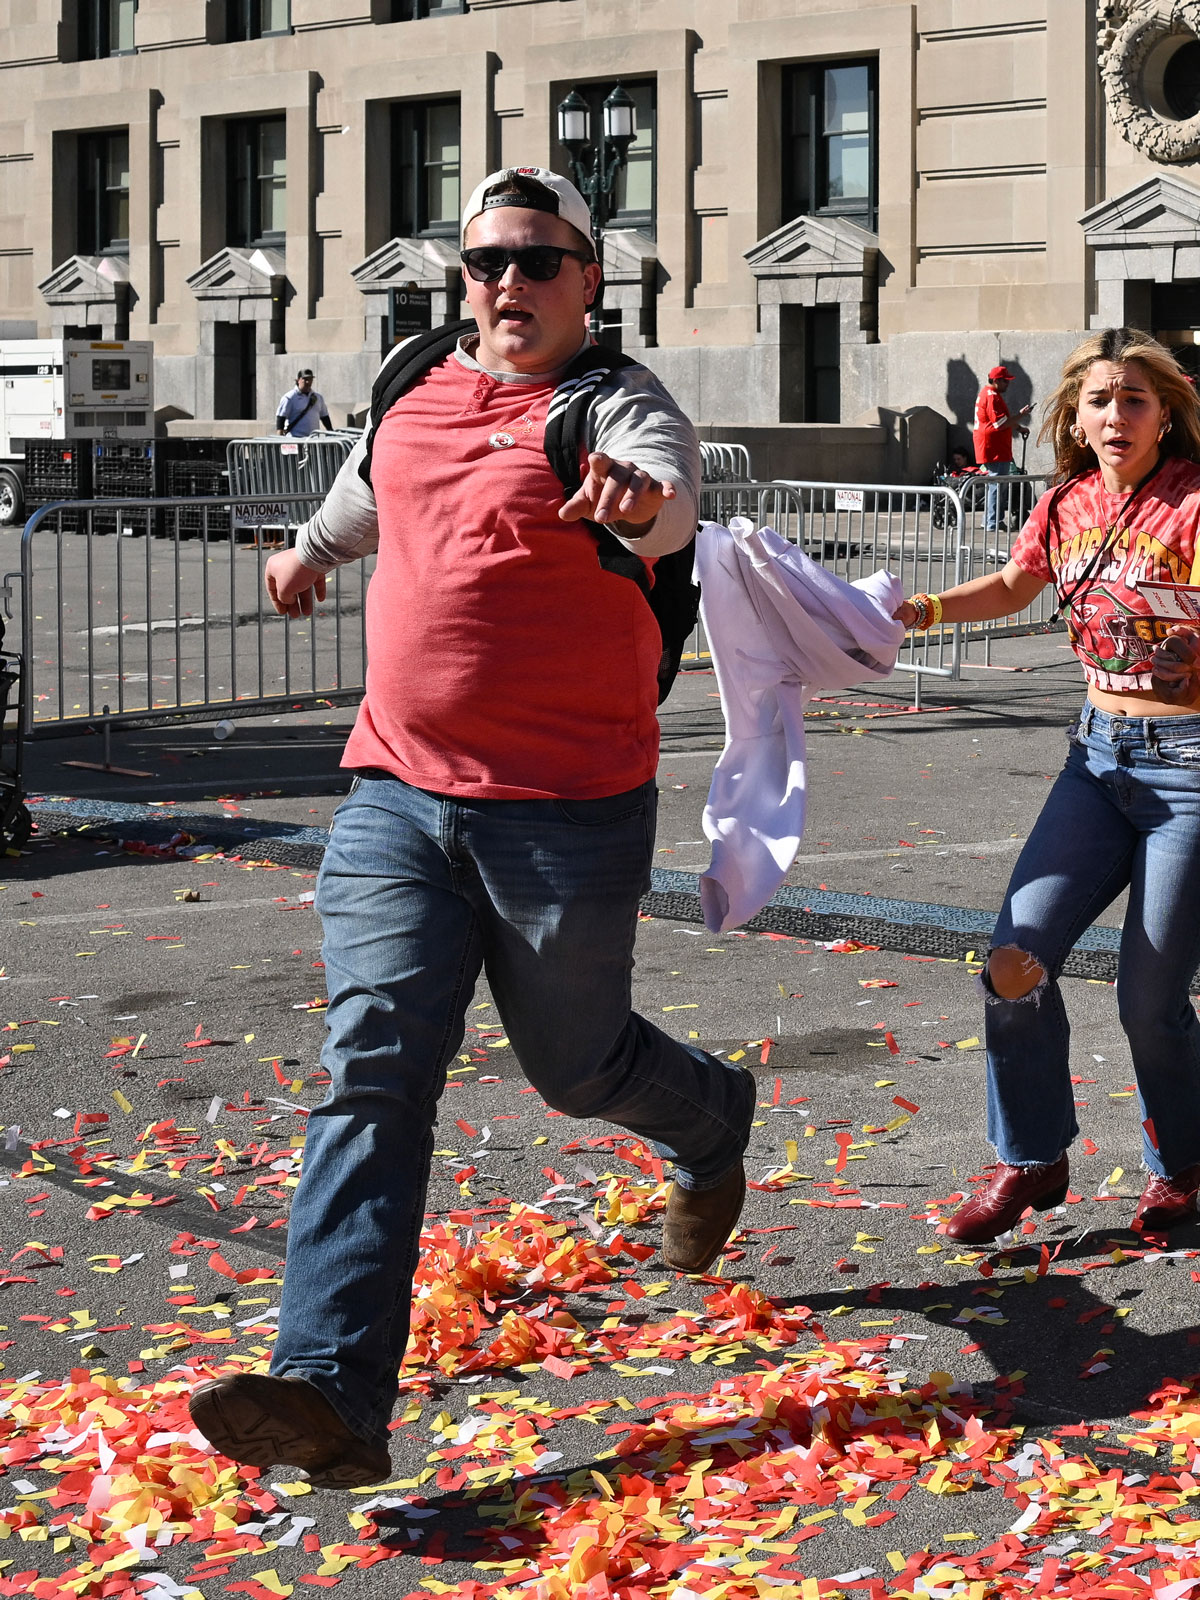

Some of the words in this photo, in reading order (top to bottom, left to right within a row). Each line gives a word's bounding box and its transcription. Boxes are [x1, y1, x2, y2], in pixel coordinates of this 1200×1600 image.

[395, 293, 407, 305] 10
[837, 491, 862, 502] NATIONAL
[235, 503, 287, 516] NATIONAL
[1124, 531, 1192, 592] CITY
